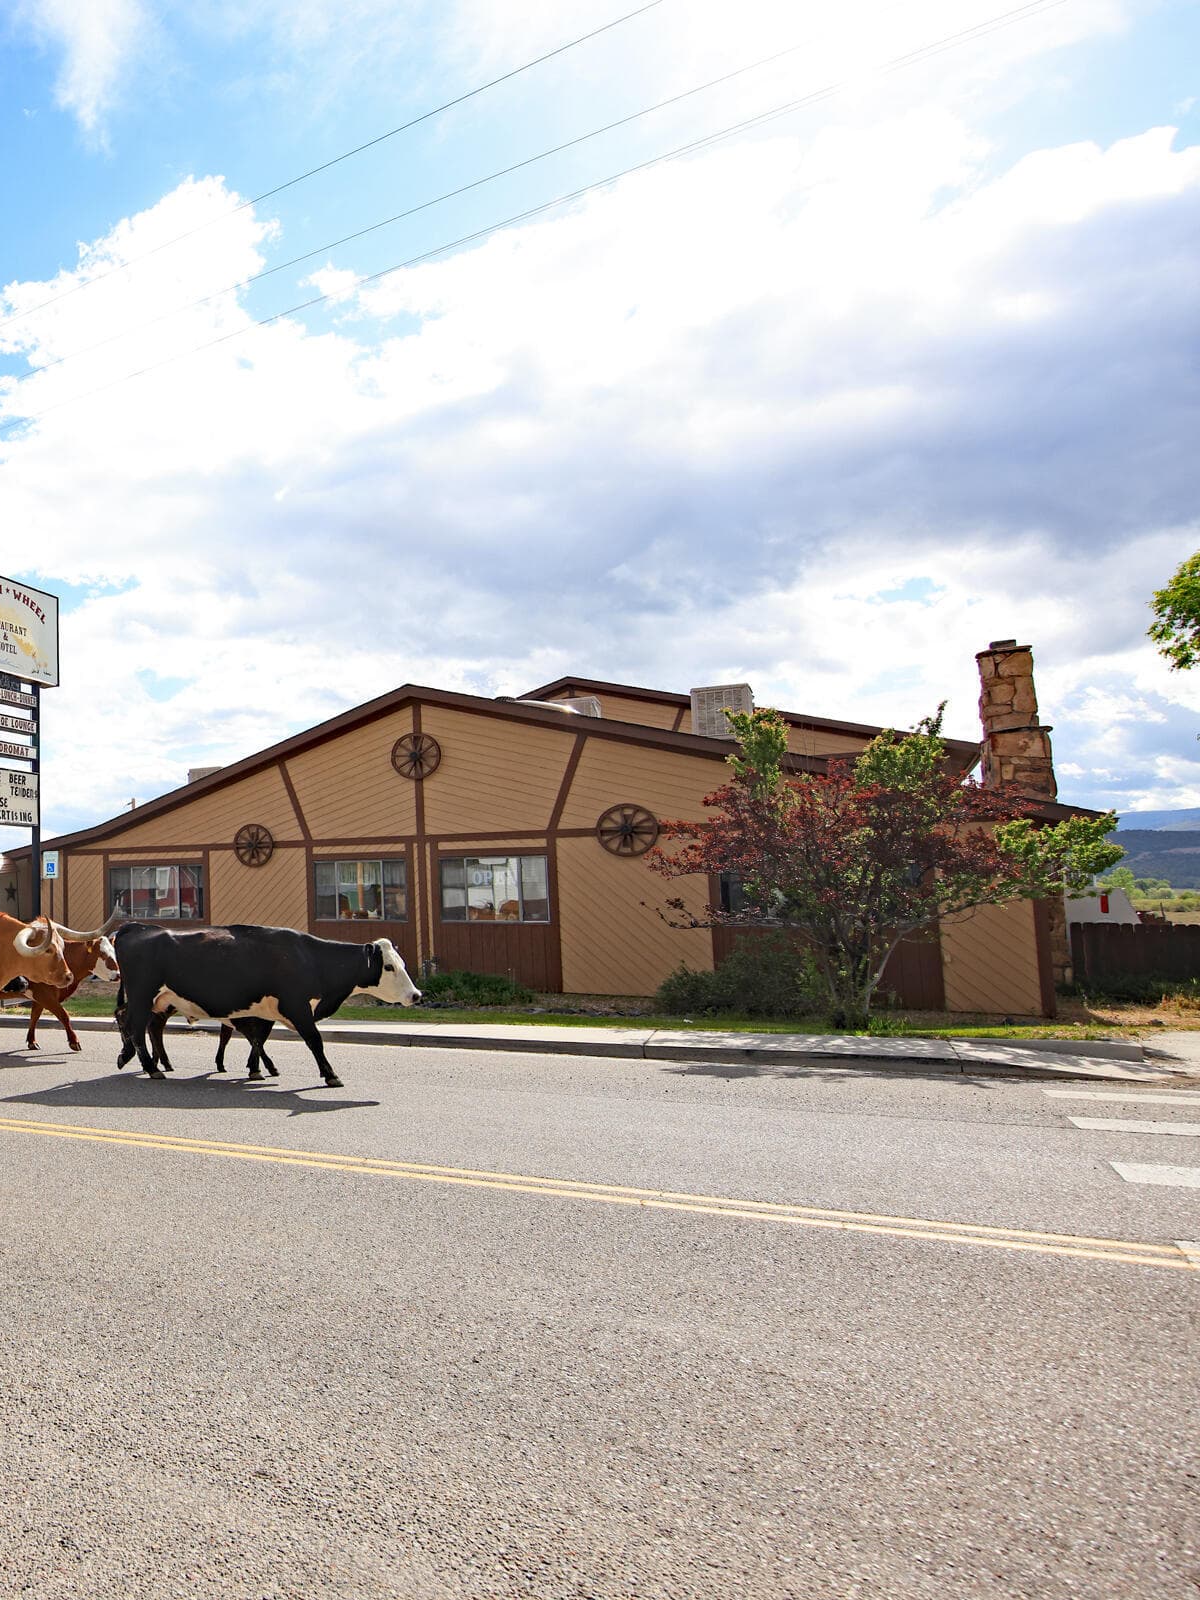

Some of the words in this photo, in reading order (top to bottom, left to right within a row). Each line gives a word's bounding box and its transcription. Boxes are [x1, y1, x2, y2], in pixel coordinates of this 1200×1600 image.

[12, 589, 46, 625] WHEEL
[3, 632, 9, 641] &
[11, 719, 35, 732] LOUNGE
[8, 773, 26, 785] BEER
